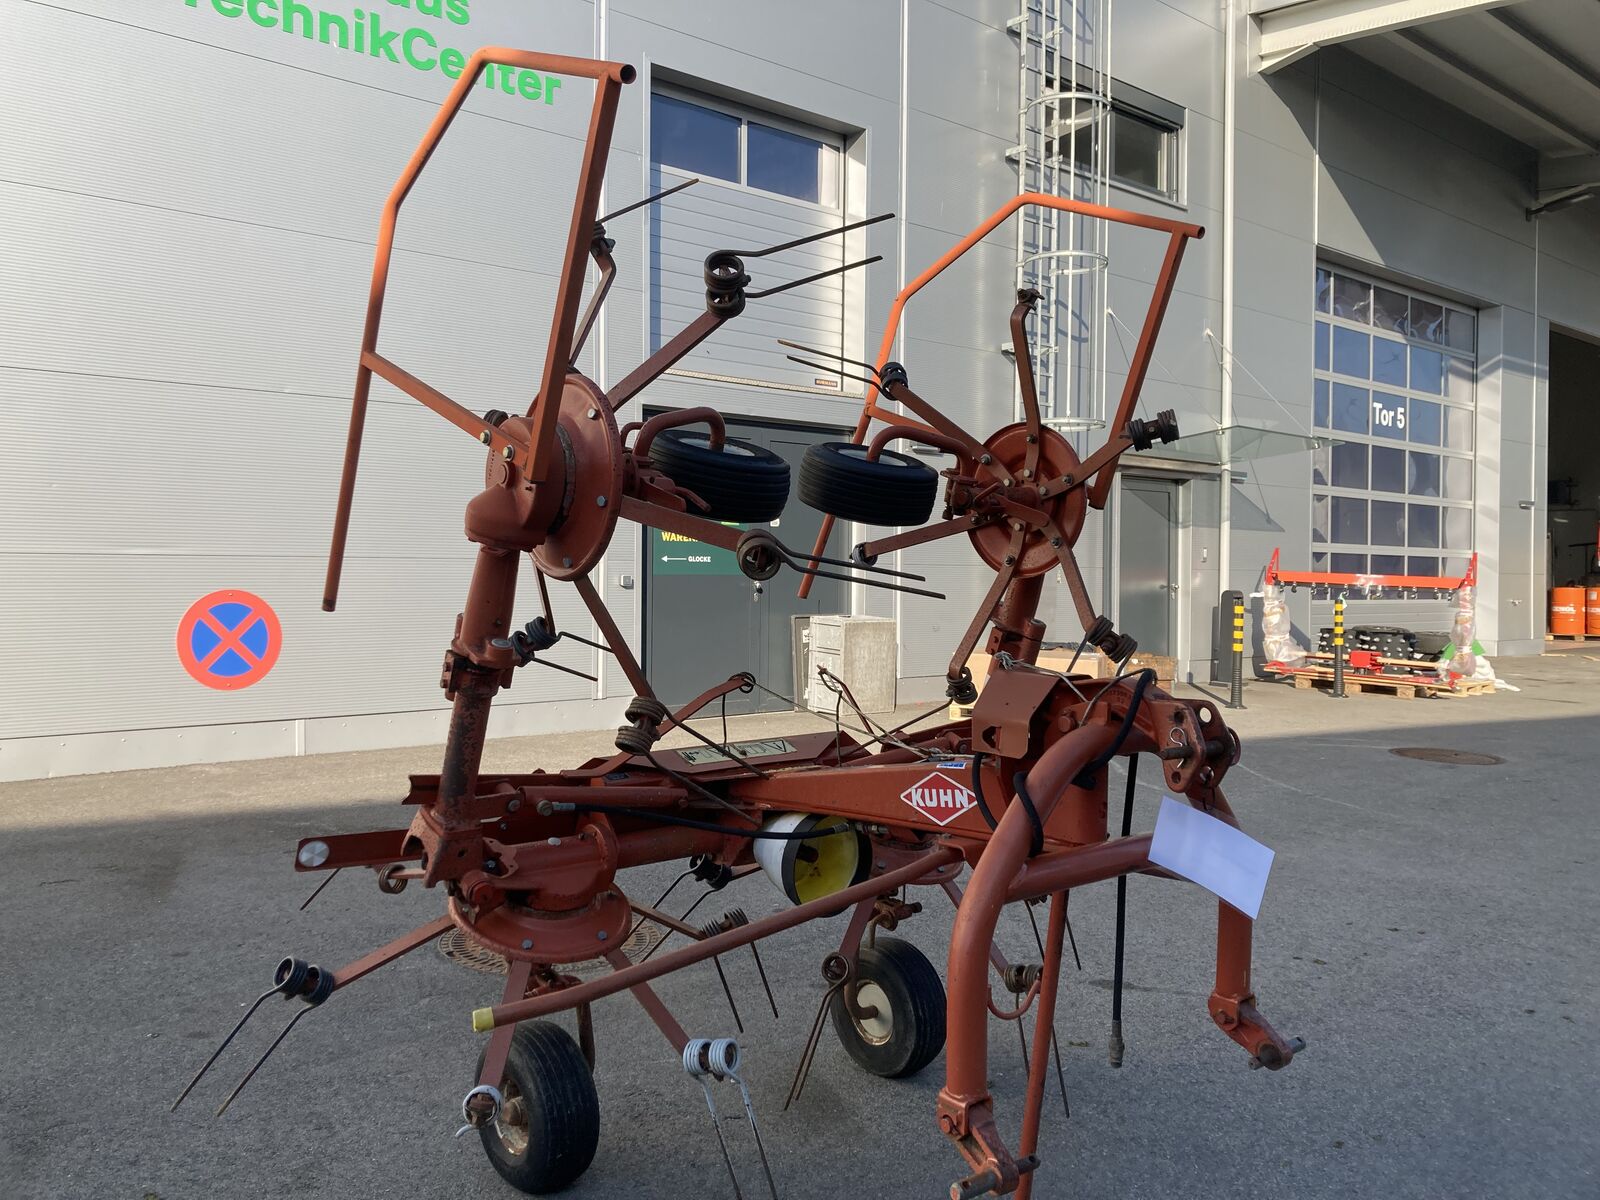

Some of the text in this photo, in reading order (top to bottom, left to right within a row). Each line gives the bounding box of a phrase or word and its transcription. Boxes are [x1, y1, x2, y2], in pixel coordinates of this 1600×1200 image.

[183, 0, 562, 105] echnikCeter
[1373, 402, 1405, 429] Tor 5
[911, 788, 969, 809] KUHN
